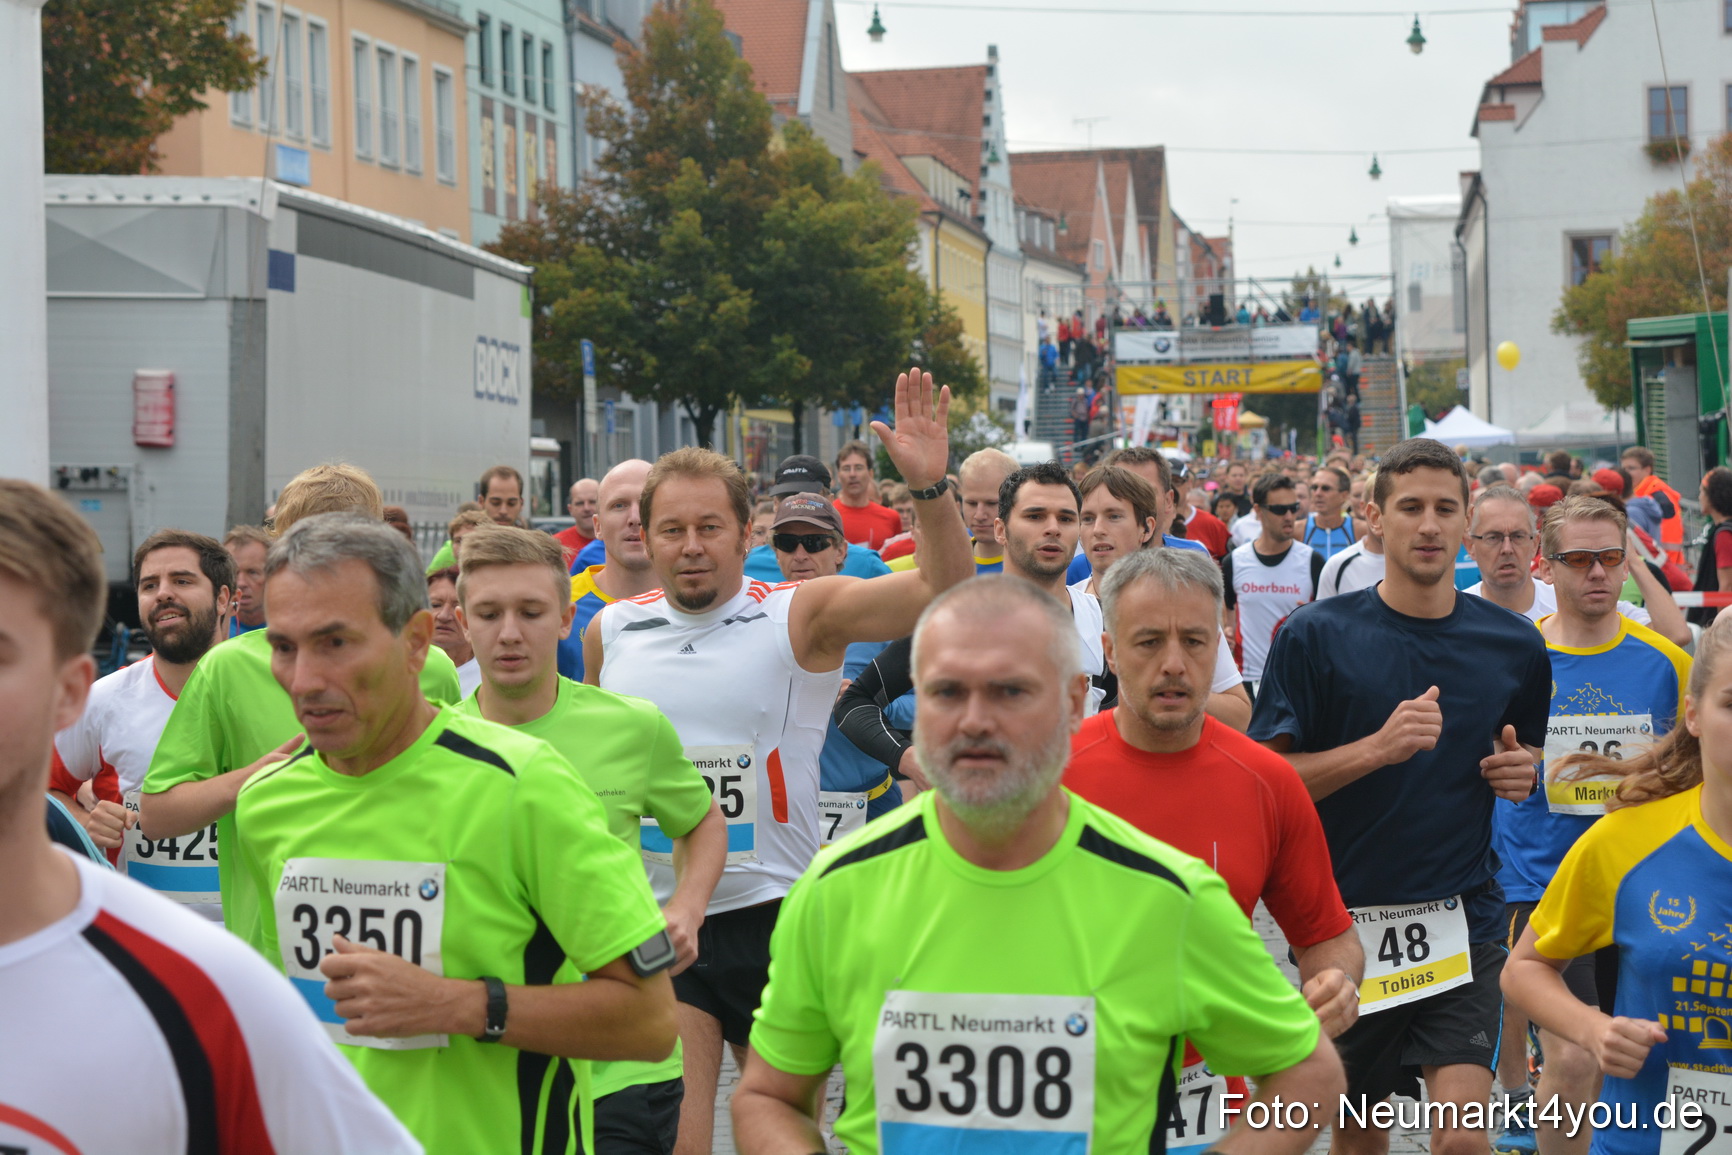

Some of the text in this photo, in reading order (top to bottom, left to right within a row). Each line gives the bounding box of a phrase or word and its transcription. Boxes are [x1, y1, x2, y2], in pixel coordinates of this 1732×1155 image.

[474, 337, 520, 404] BOCK
[1183, 369, 1254, 387] START
[1241, 582, 1301, 594] Oberbank
[1546, 726, 1636, 736] PARTL Neumarkt
[280, 876, 410, 897] PARTL Neumarkt
[1379, 902, 1440, 921] Neumarkt
[1658, 907, 1686, 919] Jahre
[1668, 898, 1680, 907] 15
[293, 903, 422, 969] 3350
[1378, 922, 1431, 968] 48
[1379, 971, 1434, 995] Tobias
[882, 1010, 1055, 1034] PARTL Neumarkt
[895, 1041, 1072, 1120] 3308
[1673, 1085, 1731, 1107] PARTL
